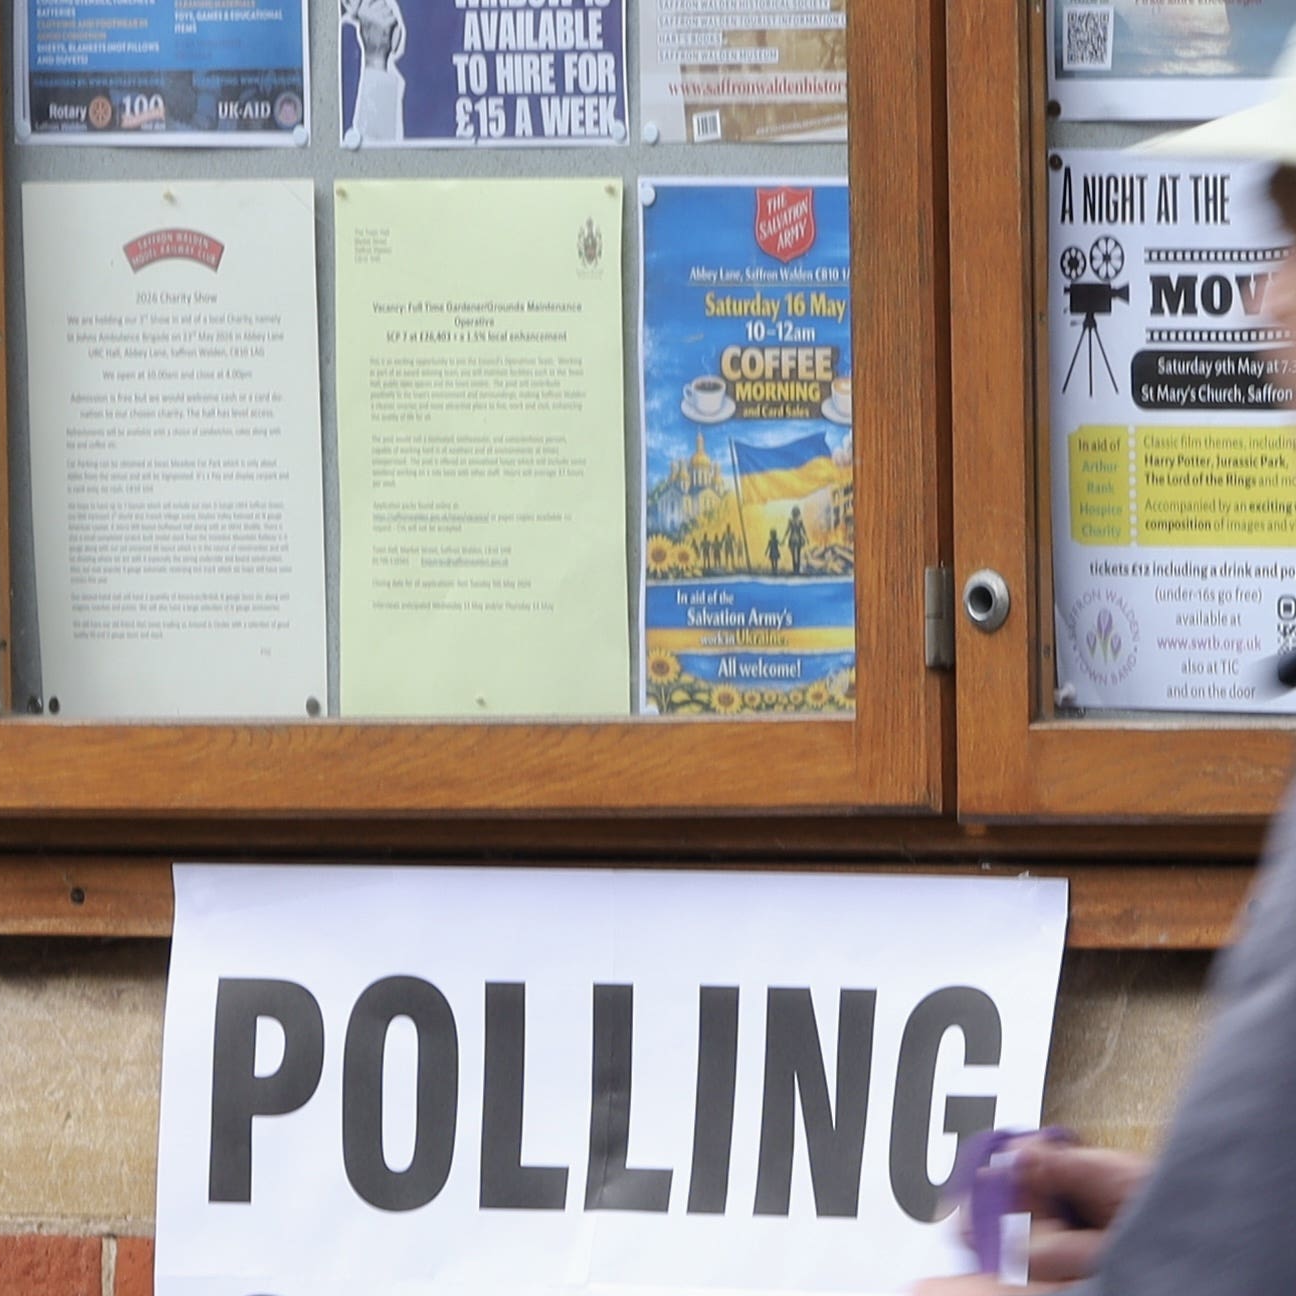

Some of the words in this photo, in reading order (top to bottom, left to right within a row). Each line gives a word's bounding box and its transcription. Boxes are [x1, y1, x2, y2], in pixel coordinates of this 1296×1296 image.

[779, 13, 839, 25] INFORMATION
[174, 23, 197, 34] ITEMS
[463, 9, 603, 51] AVAILABLE
[452, 53, 487, 95] TO
[495, 53, 555, 95] HIRE
[563, 52, 616, 93] FOR
[49, 103, 87, 121] Rotary
[455, 97, 505, 138] £15
[514, 97, 533, 137] A
[541, 95, 617, 137] WEEK
[767, 192, 787, 214] THE
[1060, 166, 1074, 224] A
[1083, 174, 1148, 225] NIGHT
[1156, 174, 1181, 224] AT
[1189, 174, 1231, 225] THE
[759, 197, 809, 241] SALVATION
[777, 219, 808, 252] ARMY
[160, 292, 192, 305] Charity
[194, 292, 217, 304] Show
[408, 302, 423, 312] Full
[425, 302, 444, 312] Time
[527, 302, 582, 312] Maintenance
[705, 291, 780, 322] Saturday
[786, 292, 805, 316] 16
[810, 293, 847, 324] May
[454, 317, 495, 328] Operative
[509, 331, 567, 342] enhancement
[720, 346, 834, 382] COFFEE
[735, 382, 821, 403] MORNING
[1141, 384, 1154, 400] St
[1156, 384, 1196, 405] Mary's
[1198, 383, 1245, 402] Church,
[1248, 384, 1292, 400] Saffron
[1079, 440, 1089, 451] In
[1090, 439, 1106, 451] aid
[1109, 439, 1121, 451] of
[1143, 436, 1178, 450] Classic
[1180, 436, 1202, 449] film
[1144, 455, 1175, 469] Harry
[1178, 455, 1214, 469] Potter,
[1216, 455, 1258, 470] Jurassic
[1260, 456, 1289, 470] Park,
[1144, 473, 1164, 486] The
[1167, 473, 1190, 486] Lord
[1192, 473, 1204, 486] of
[1205, 473, 1223, 486] the
[1226, 474, 1256, 489] Rings
[1259, 474, 1277, 487] and
[1144, 500, 1215, 516] Accompanied
[1217, 501, 1231, 515] by
[1233, 503, 1247, 513] an
[1249, 500, 1292, 515] exciting
[1145, 517, 1211, 534] composition
[1213, 518, 1225, 531] of
[1226, 519, 1263, 534] images
[1266, 518, 1286, 532] and
[1089, 562, 1129, 577] tickets
[1131, 563, 1150, 577] £12
[1152, 562, 1208, 580] including
[1210, 566, 1218, 577] a
[1219, 562, 1252, 578] drink
[1254, 563, 1278, 578] and
[677, 590, 688, 604] In
[690, 590, 705, 604] aid
[707, 590, 719, 604] of
[720, 591, 734, 604] the
[1154, 586, 1215, 603] (under-16s
[1218, 590, 1233, 603] go
[1234, 586, 1263, 603] free)
[687, 609, 745, 626] Salvation
[748, 608, 792, 630] Army's
[1176, 612, 1227, 627] available
[1229, 613, 1242, 626] at
[1157, 635, 1261, 653] www.swtb.org.uk
[718, 658, 736, 677] All
[739, 659, 801, 678] welcome!
[1181, 660, 1204, 674] also
[1206, 661, 1219, 674] at
[1221, 660, 1239, 674] TIC
[1167, 685, 1188, 698] and
[1190, 688, 1205, 698] on
[1207, 685, 1226, 698] the
[1228, 684, 1256, 699] door
[208, 975, 1002, 1224] POLLING
